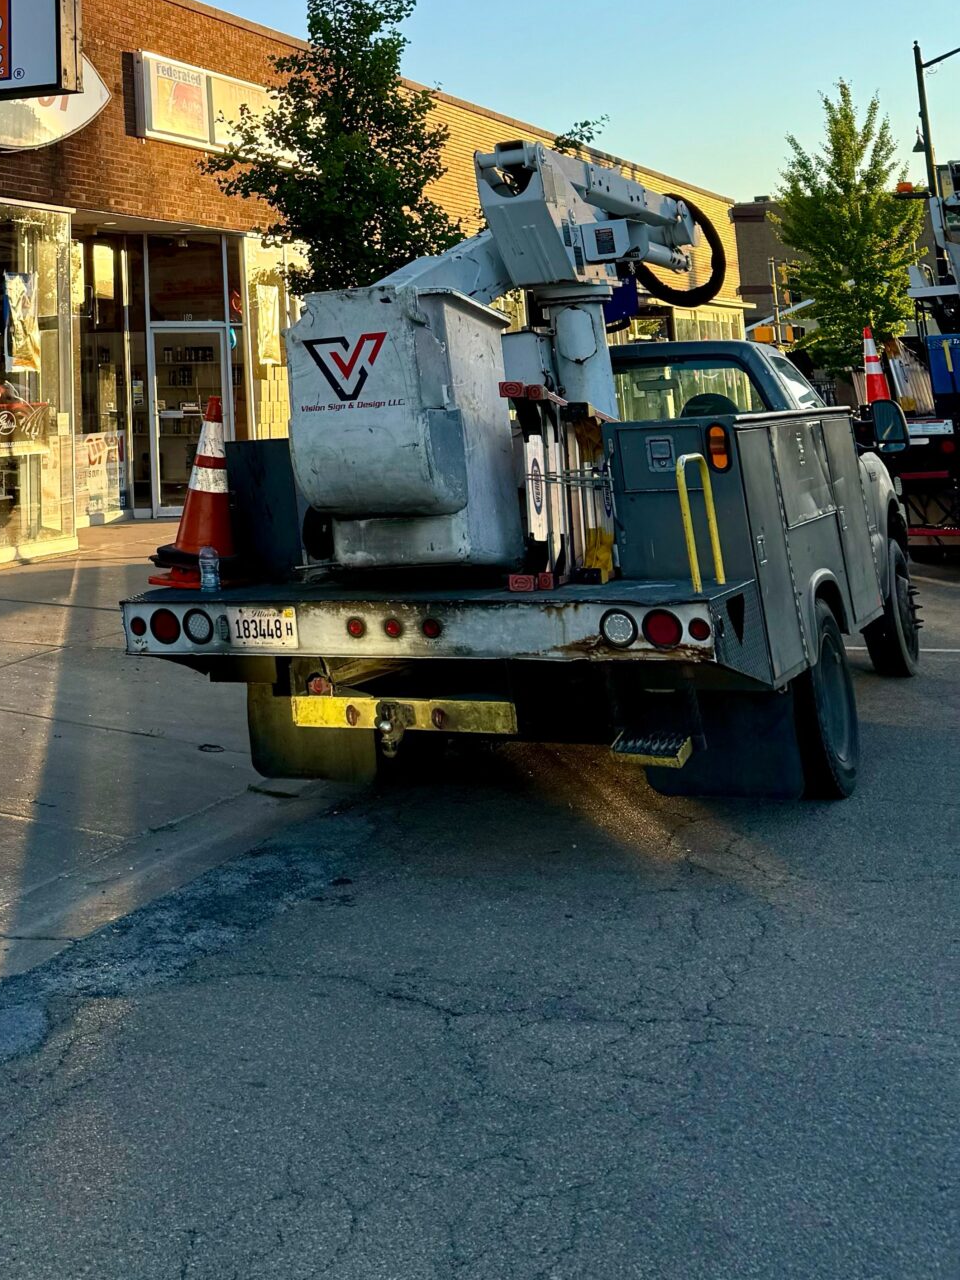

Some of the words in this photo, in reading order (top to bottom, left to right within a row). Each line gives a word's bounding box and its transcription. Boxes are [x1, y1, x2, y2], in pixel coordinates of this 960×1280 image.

[156, 62, 202, 86] Federated
[328, 403, 345, 411] Sign
[357, 401, 385, 409] Design
[235, 619, 282, 639] 183448
[285, 622, 293, 636] H
